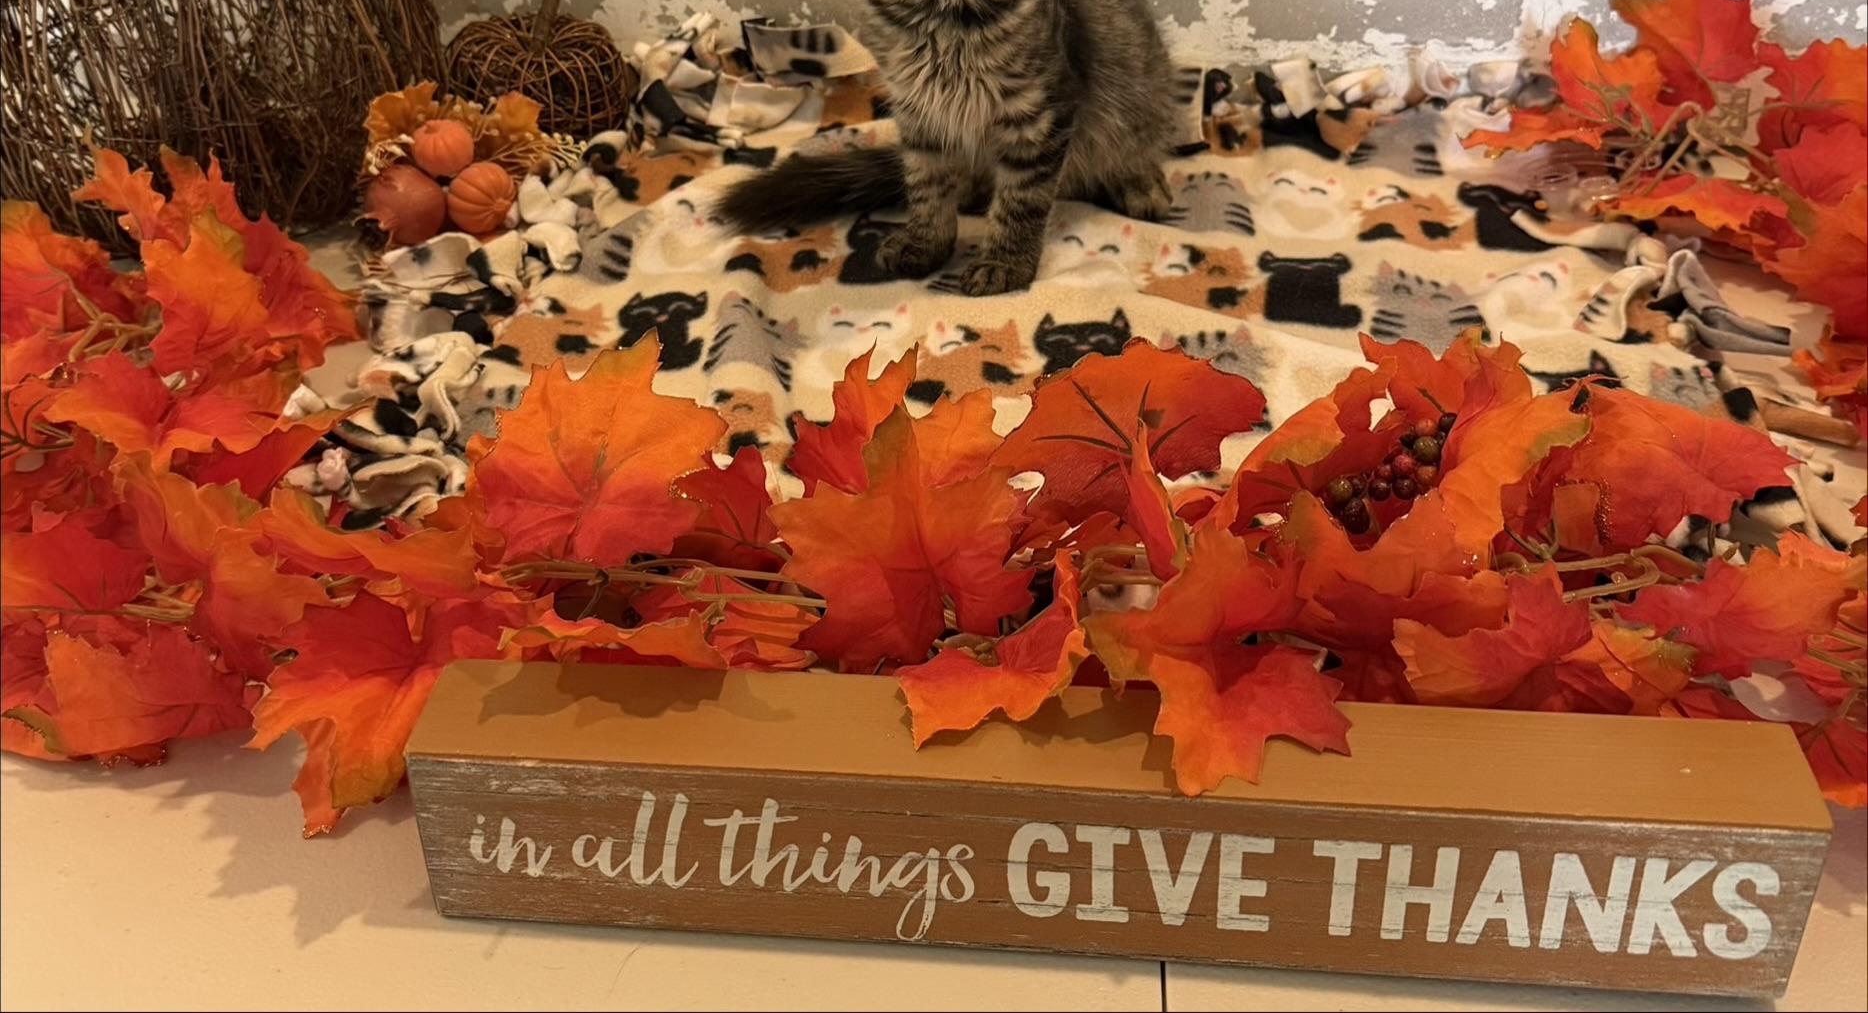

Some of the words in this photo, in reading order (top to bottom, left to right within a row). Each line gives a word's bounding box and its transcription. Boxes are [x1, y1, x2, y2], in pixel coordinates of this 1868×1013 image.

[467, 813, 553, 878] in
[571, 790, 699, 889] all
[703, 797, 976, 942] things
[1006, 821, 1275, 933] GIVE
[1312, 839, 1781, 961] THANKS
